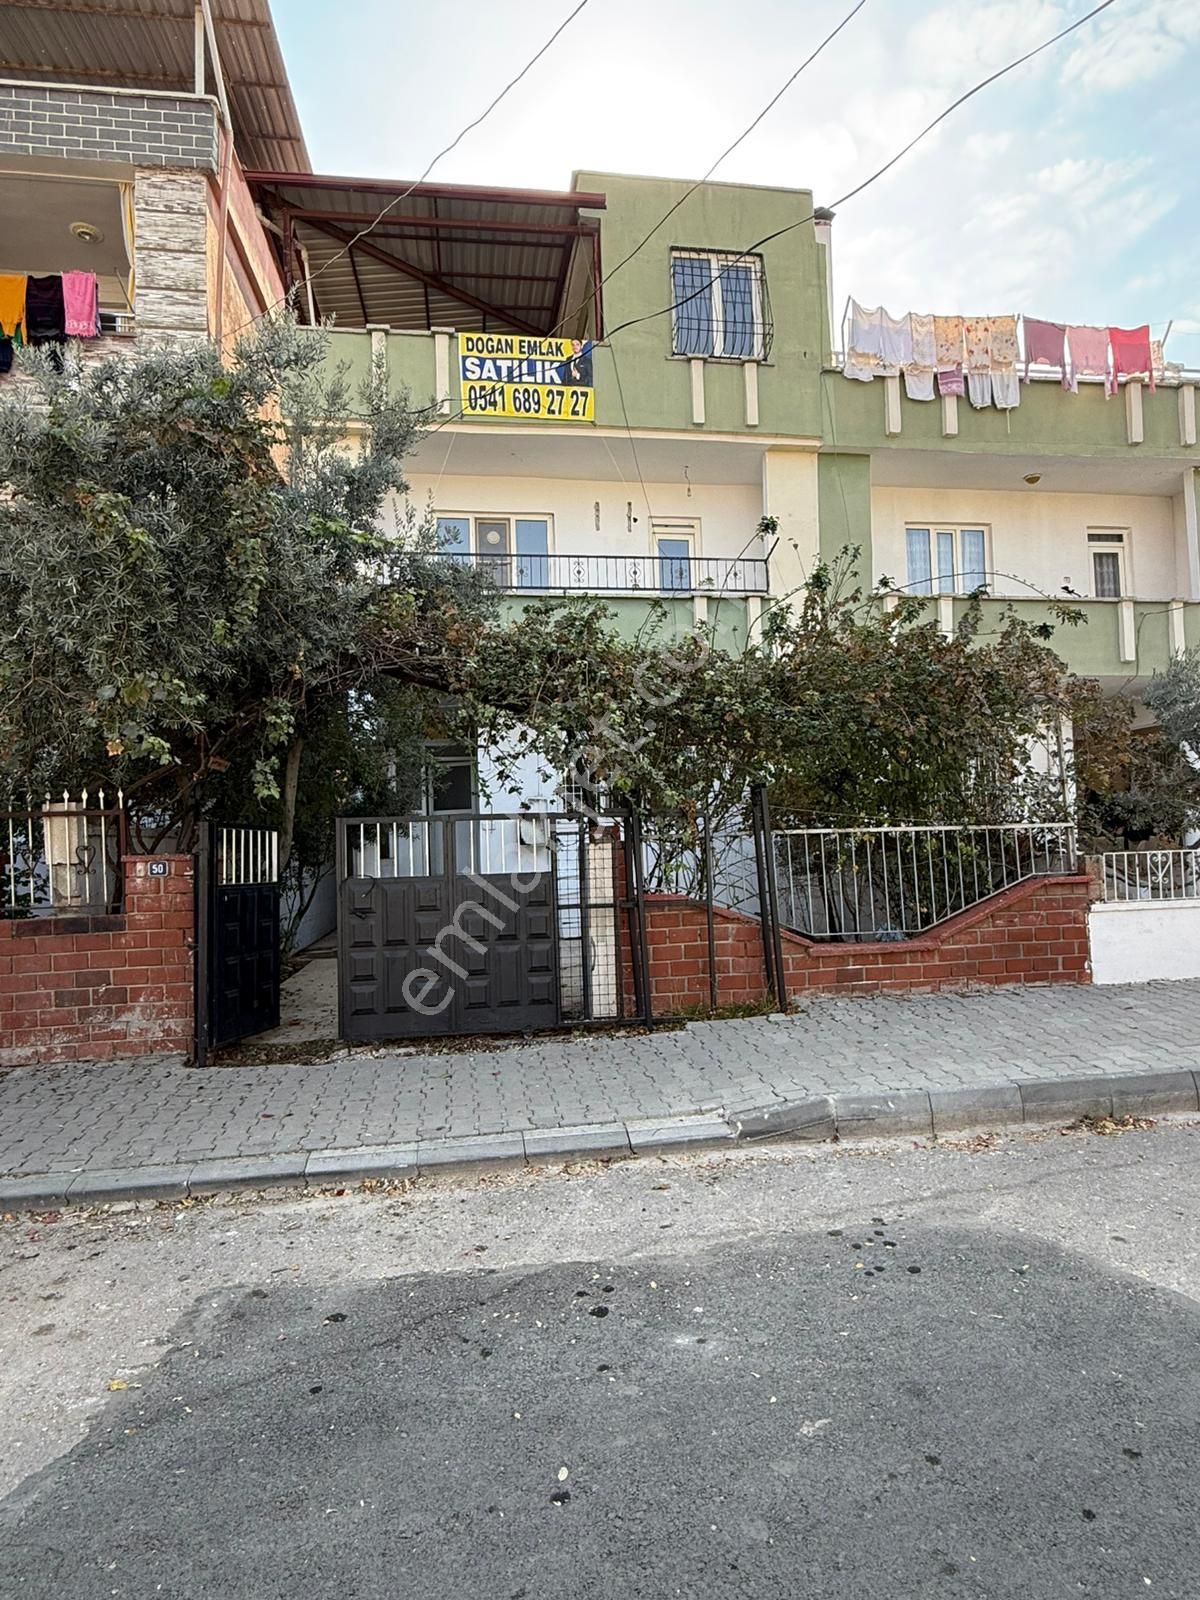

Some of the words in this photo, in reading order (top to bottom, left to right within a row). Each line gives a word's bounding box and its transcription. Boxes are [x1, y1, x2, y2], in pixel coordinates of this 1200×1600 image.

[518, 339, 564, 357] EMLAK
[464, 356, 562, 384] SATILIK
[468, 384, 506, 411] 0541
[513, 387, 541, 413] 689
[546, 389, 565, 415] 27
[570, 390, 589, 416] 27
[152, 864, 164, 874] 50
